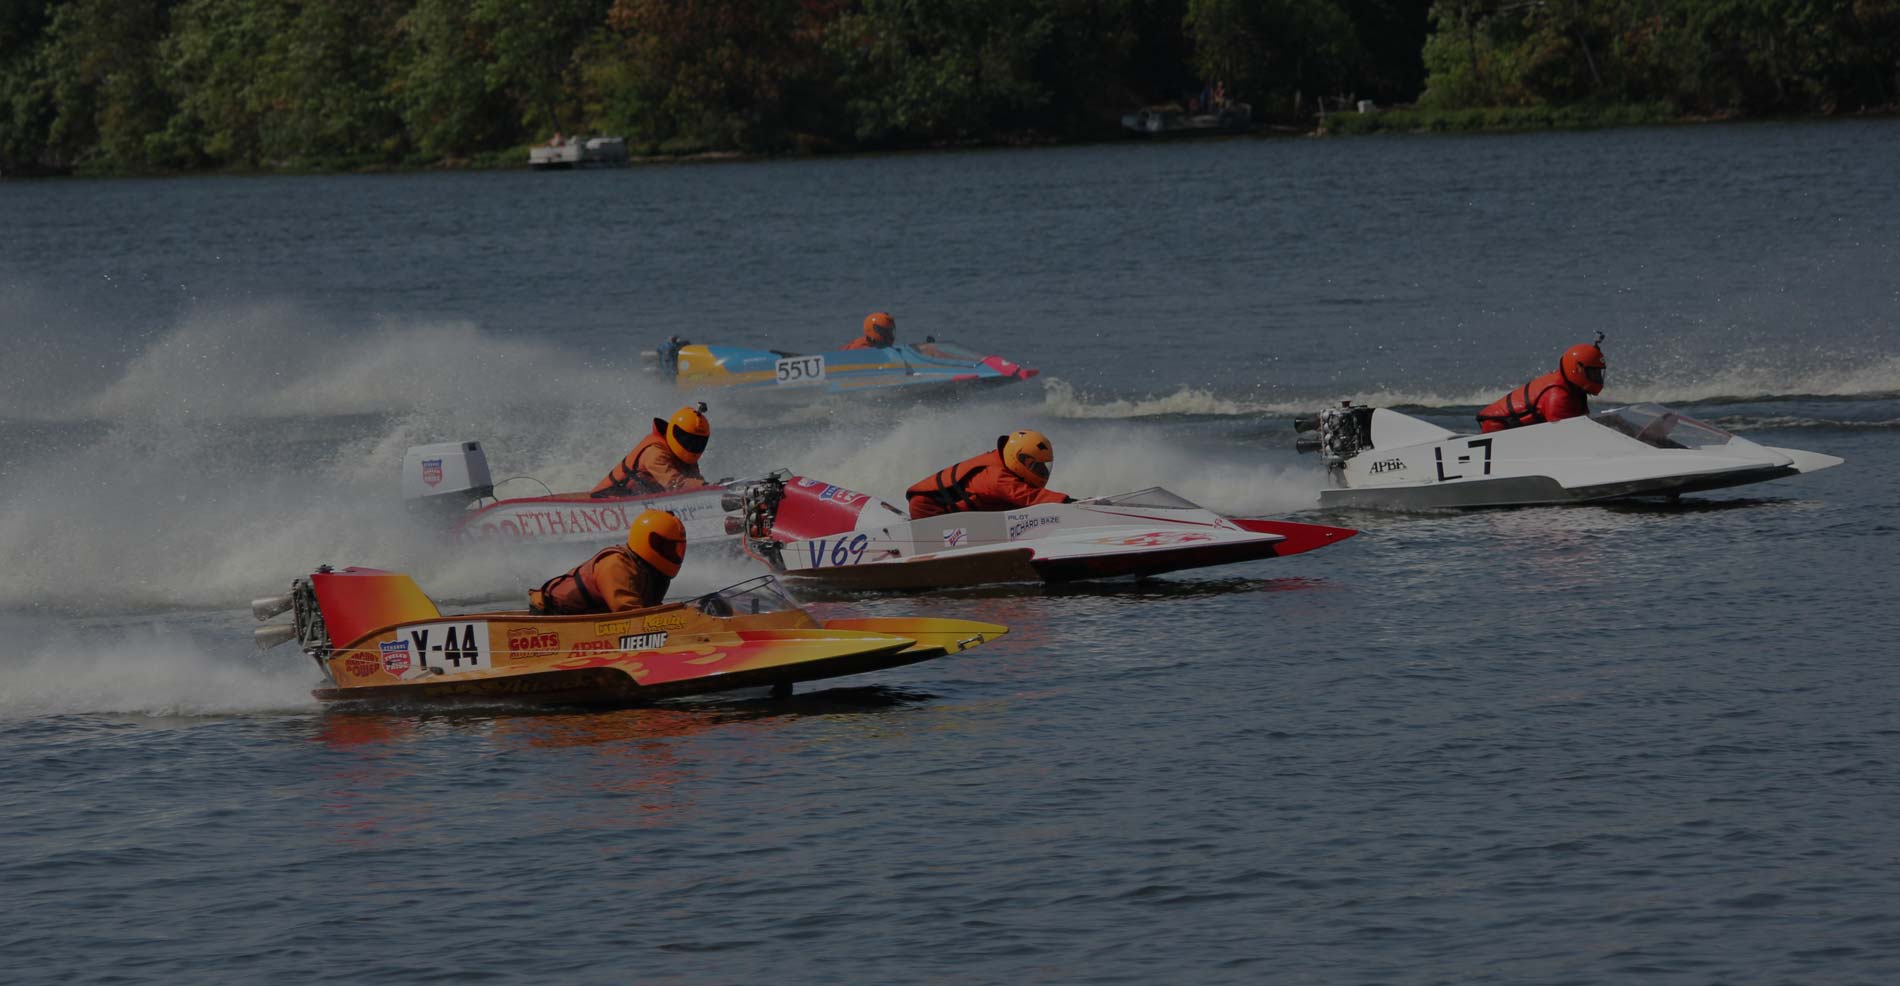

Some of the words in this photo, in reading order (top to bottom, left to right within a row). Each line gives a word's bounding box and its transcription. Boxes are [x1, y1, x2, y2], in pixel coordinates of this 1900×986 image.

[778, 358, 821, 381] 55U
[1434, 438, 1493, 481] L-7
[411, 624, 479, 671] Y-44
[510, 634, 558, 650] GOATS
